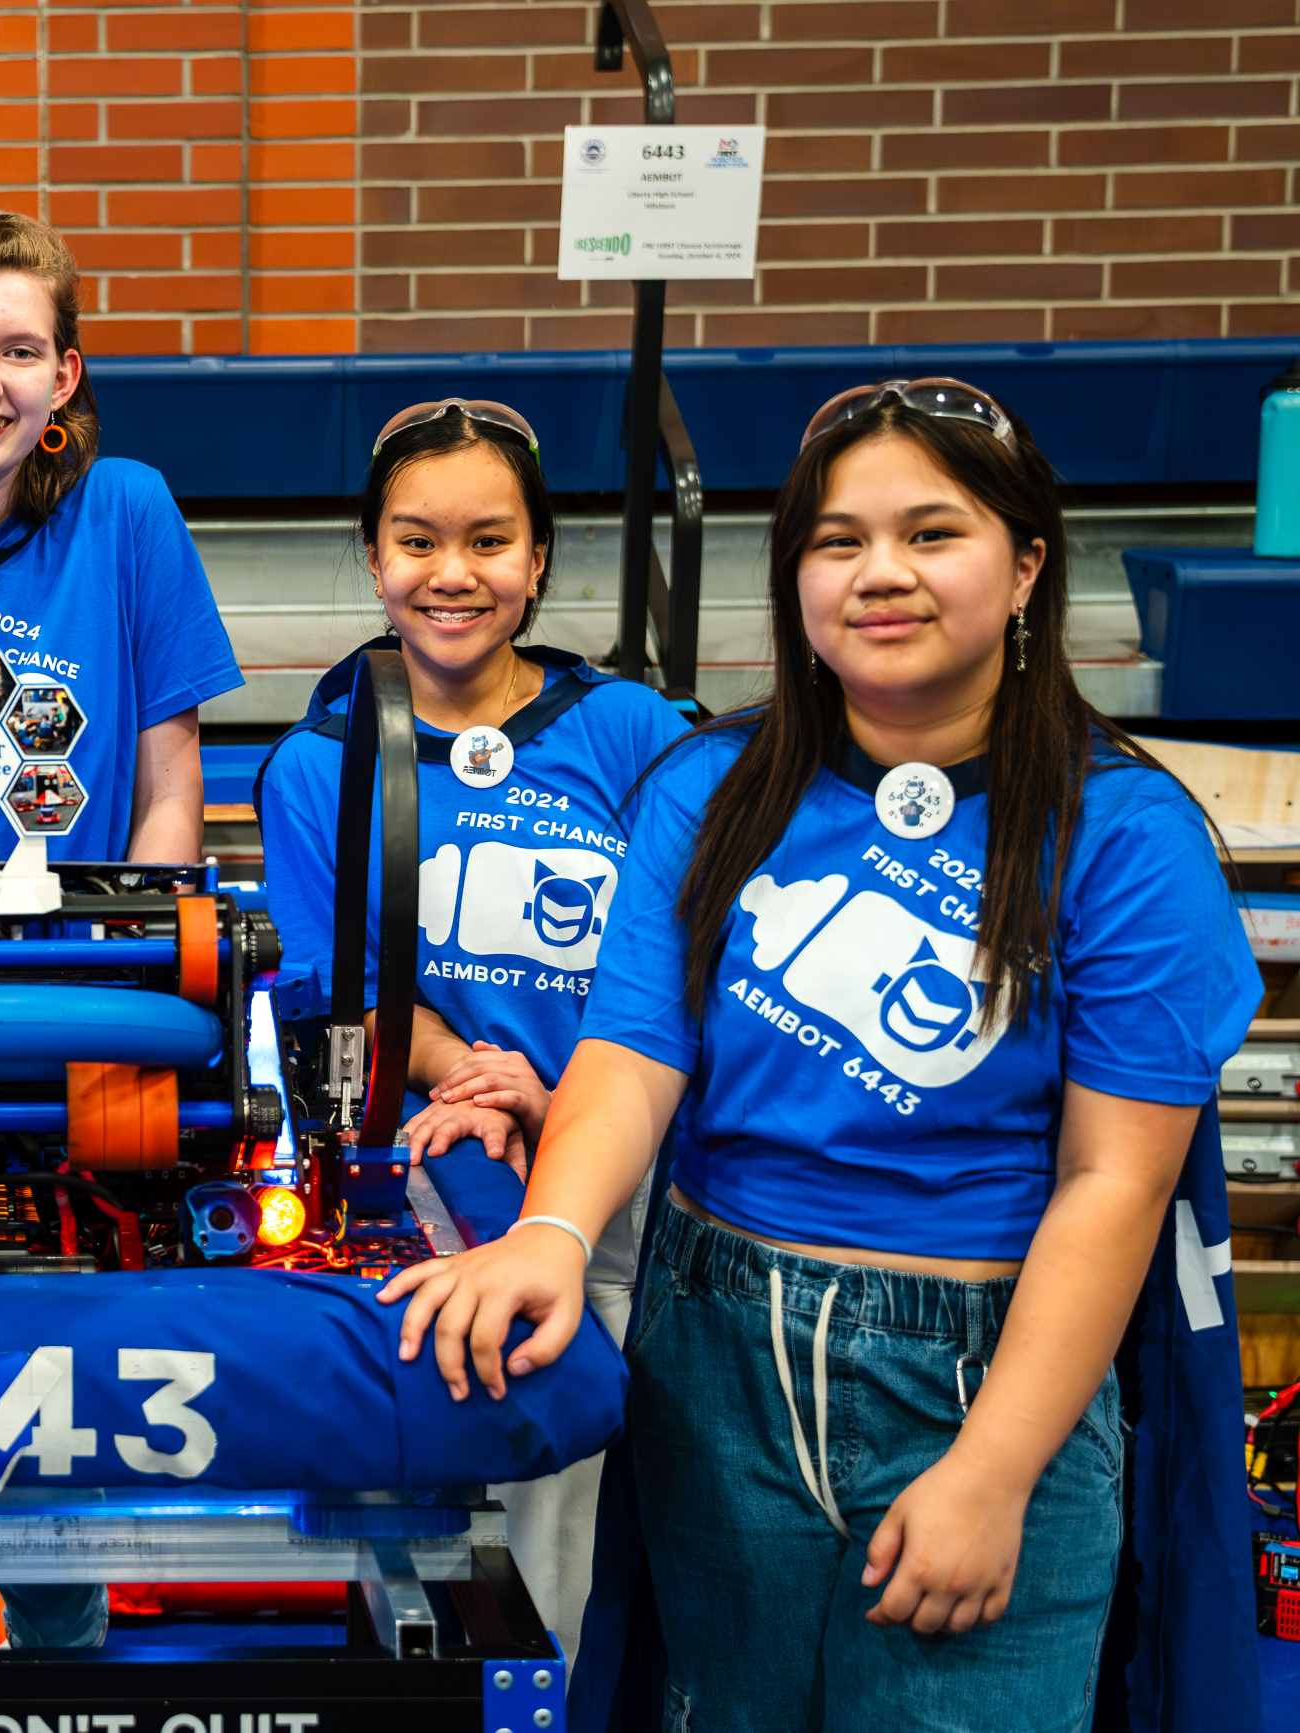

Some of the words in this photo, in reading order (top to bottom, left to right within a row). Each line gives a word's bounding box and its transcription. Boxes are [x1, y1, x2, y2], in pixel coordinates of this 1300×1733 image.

[642, 145, 685, 160] 6443
[4, 648, 80, 679] CHANCE
[505, 787, 570, 812] 2024
[456, 811, 524, 832] FIRST
[533, 820, 628, 858] CHANCE
[861, 844, 938, 898] FIRST
[424, 960, 526, 987] AEMBOT
[534, 972, 592, 996] 6443
[728, 978, 842, 1058] AEMBOT
[843, 1057, 922, 1116] 6443
